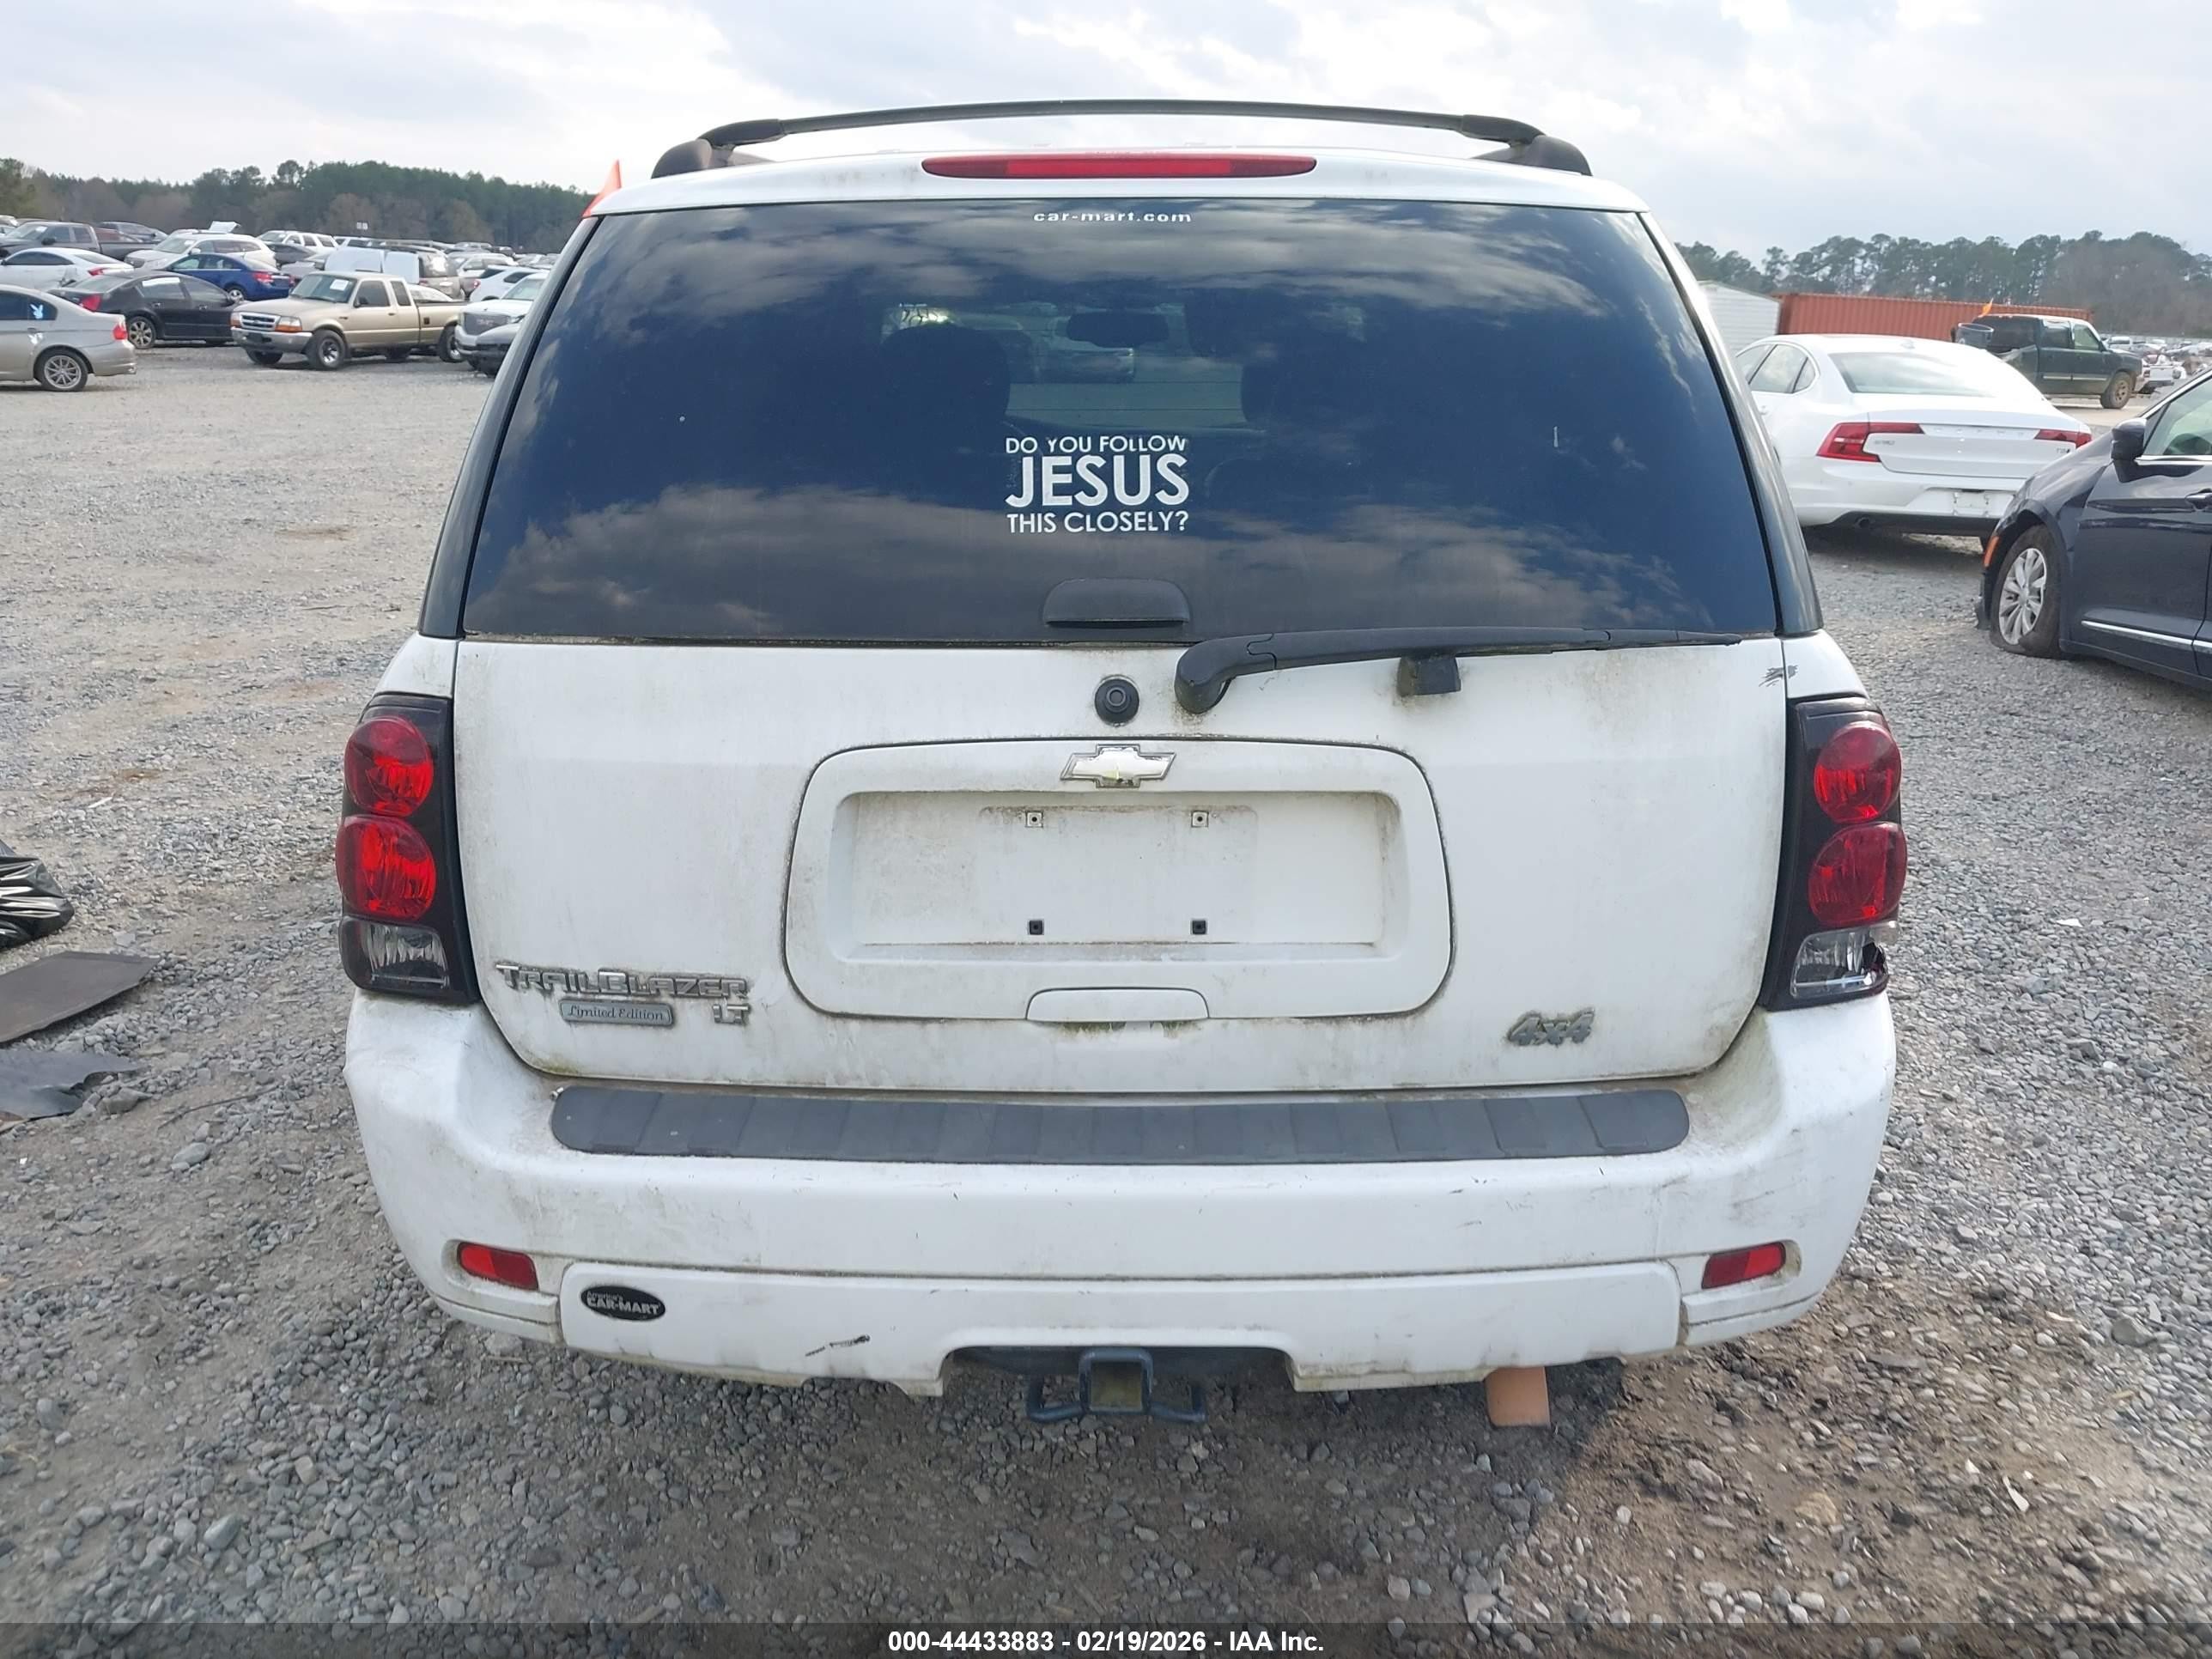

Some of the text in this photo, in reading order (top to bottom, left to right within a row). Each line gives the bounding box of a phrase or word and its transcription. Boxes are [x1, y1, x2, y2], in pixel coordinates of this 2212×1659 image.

[1033, 211, 1192, 223] car-mart.com
[1006, 434, 1187, 453] DO YOU FOLLOW
[1005, 453, 1189, 507] JESUS
[1006, 510, 1189, 533] THIS CLOSELY?
[568, 1003, 664, 1021] Limited Edition
[586, 1296, 661, 1315] CAR-MART
